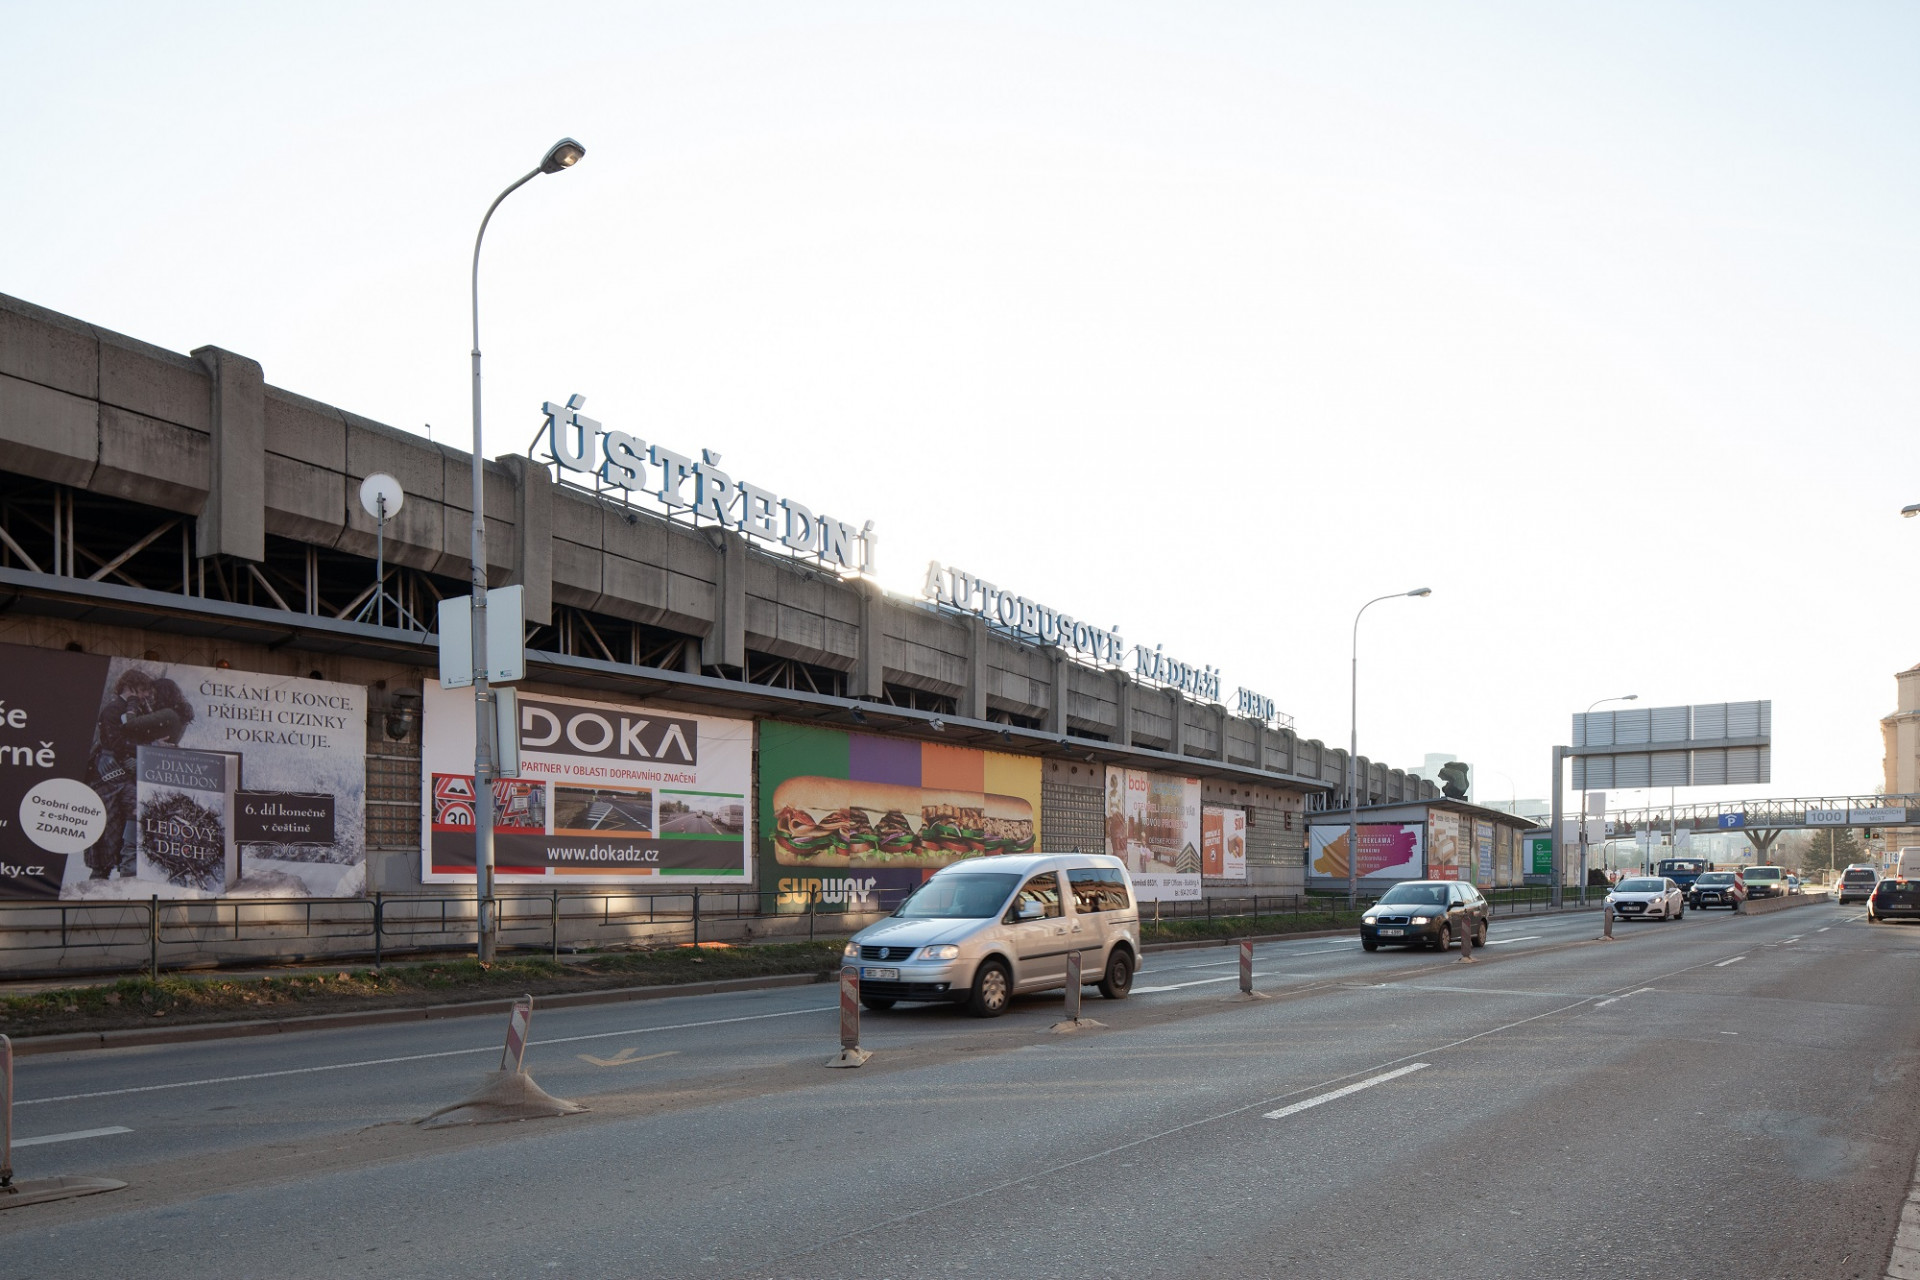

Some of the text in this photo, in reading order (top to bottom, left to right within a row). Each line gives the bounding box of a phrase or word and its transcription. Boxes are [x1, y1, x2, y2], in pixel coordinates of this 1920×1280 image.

[541, 393, 1276, 721] ÚSTŘEDNÍ AUTOBUSOVÉ NÁDRAŽÍ BRNO
[200, 680, 354, 711] ČEKÁNÍ U KONCE.
[207, 703, 347, 730] PŘÍBĚH CIZINKY
[225, 727, 331, 749] POKRAČUJE.
[522, 706, 693, 761] DOKA
[161, 759, 203, 775] DIANA
[521, 760, 562, 774] PARTNER
[564, 765, 571, 774] V
[574, 765, 608, 777] OBLASTI
[609, 767, 661, 782] DOPRAVNÍHO
[663, 772, 697, 784] ZNAČENÍ
[145, 769, 218, 789] GABALDON
[1128, 774, 1151, 794] baby
[31, 795, 102, 817] Osobní odběr
[245, 802, 326, 818] 6. díl konečně
[48, 812, 89, 826] e-shopu
[262, 822, 311, 833] v češtině
[1811, 812, 1842, 822] 1000
[36, 822, 86, 839] ZDARMA
[155, 838, 206, 860] DECH
[547, 844, 660, 862] www.dokadz.cz
[777, 876, 877, 904] SUBWAY
